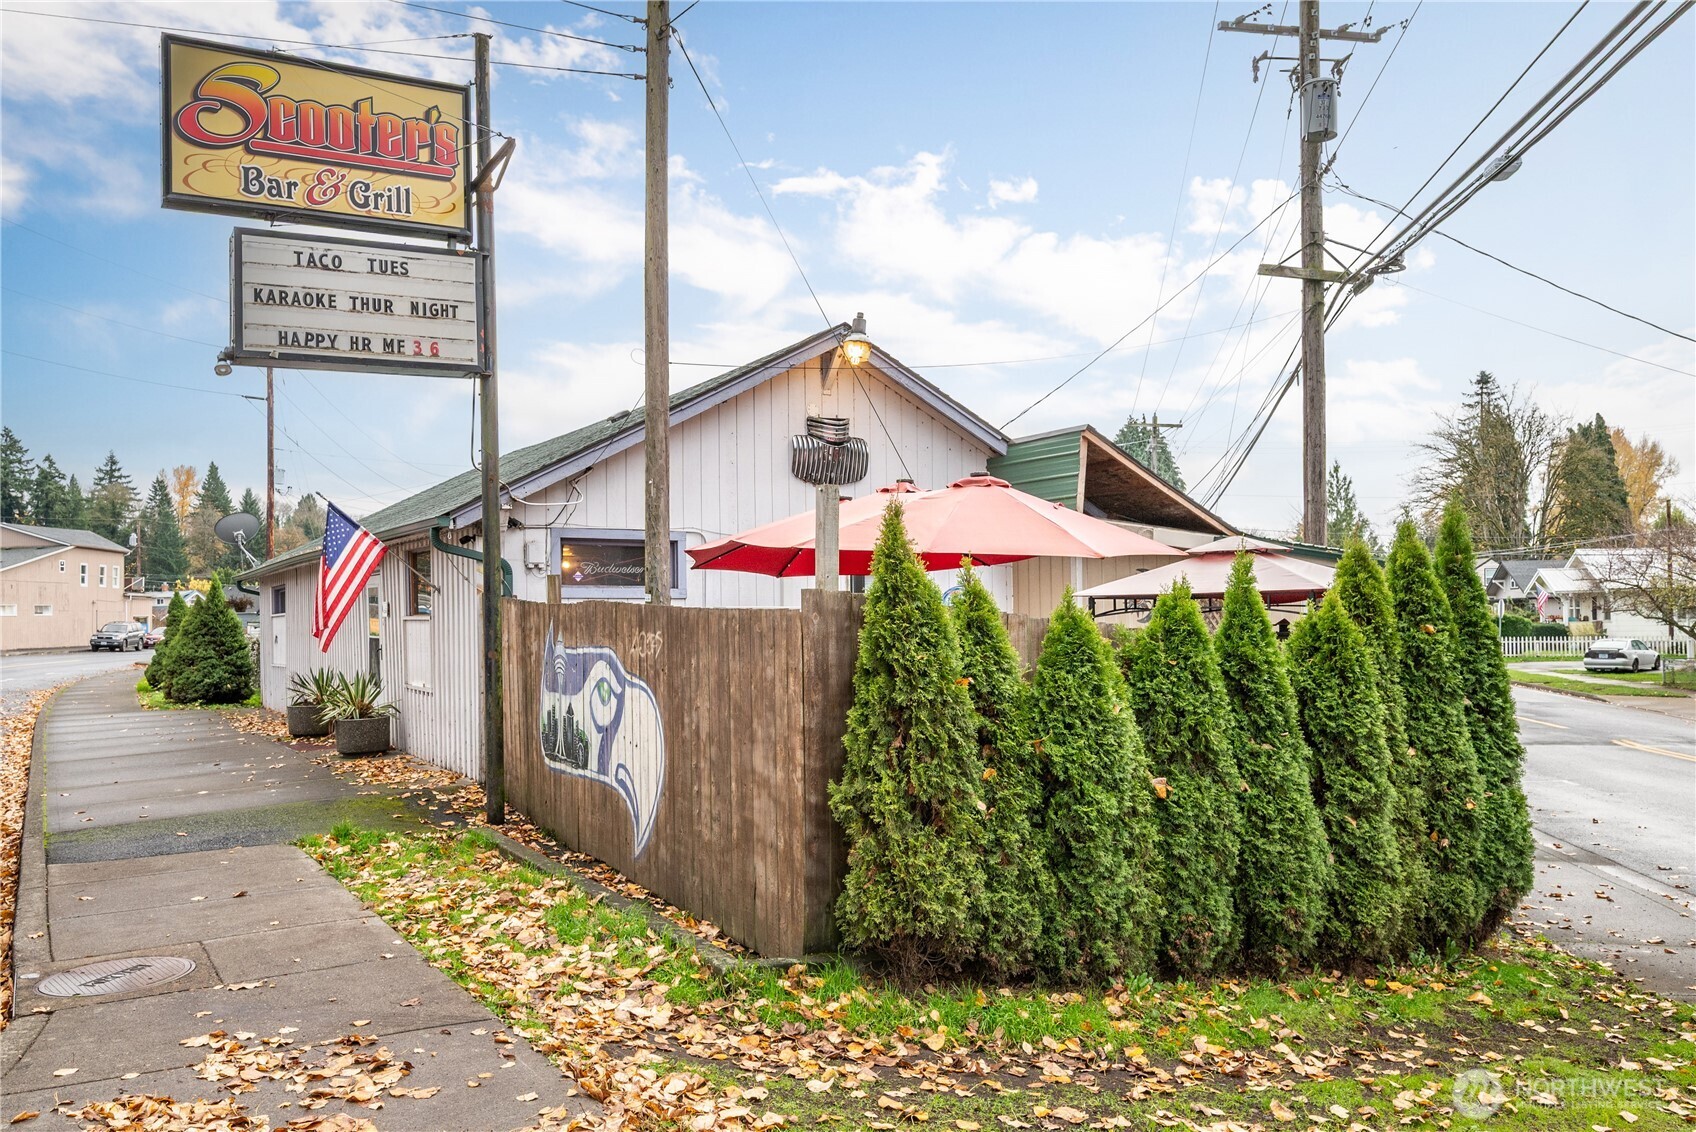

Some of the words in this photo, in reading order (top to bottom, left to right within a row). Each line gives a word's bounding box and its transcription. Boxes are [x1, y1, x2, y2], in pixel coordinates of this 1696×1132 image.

[175, 62, 460, 168] Scooter's
[240, 164, 299, 201] Bar
[305, 168, 347, 206] &
[348, 179, 414, 216] Grill
[293, 250, 343, 269] TACO
[367, 258, 409, 276] TUES
[253, 287, 337, 309] KARAOKE
[349, 295, 394, 314] THUR
[410, 300, 459, 318] NIGHT
[278, 330, 339, 349] HAPPY
[350, 336, 372, 353] HR
